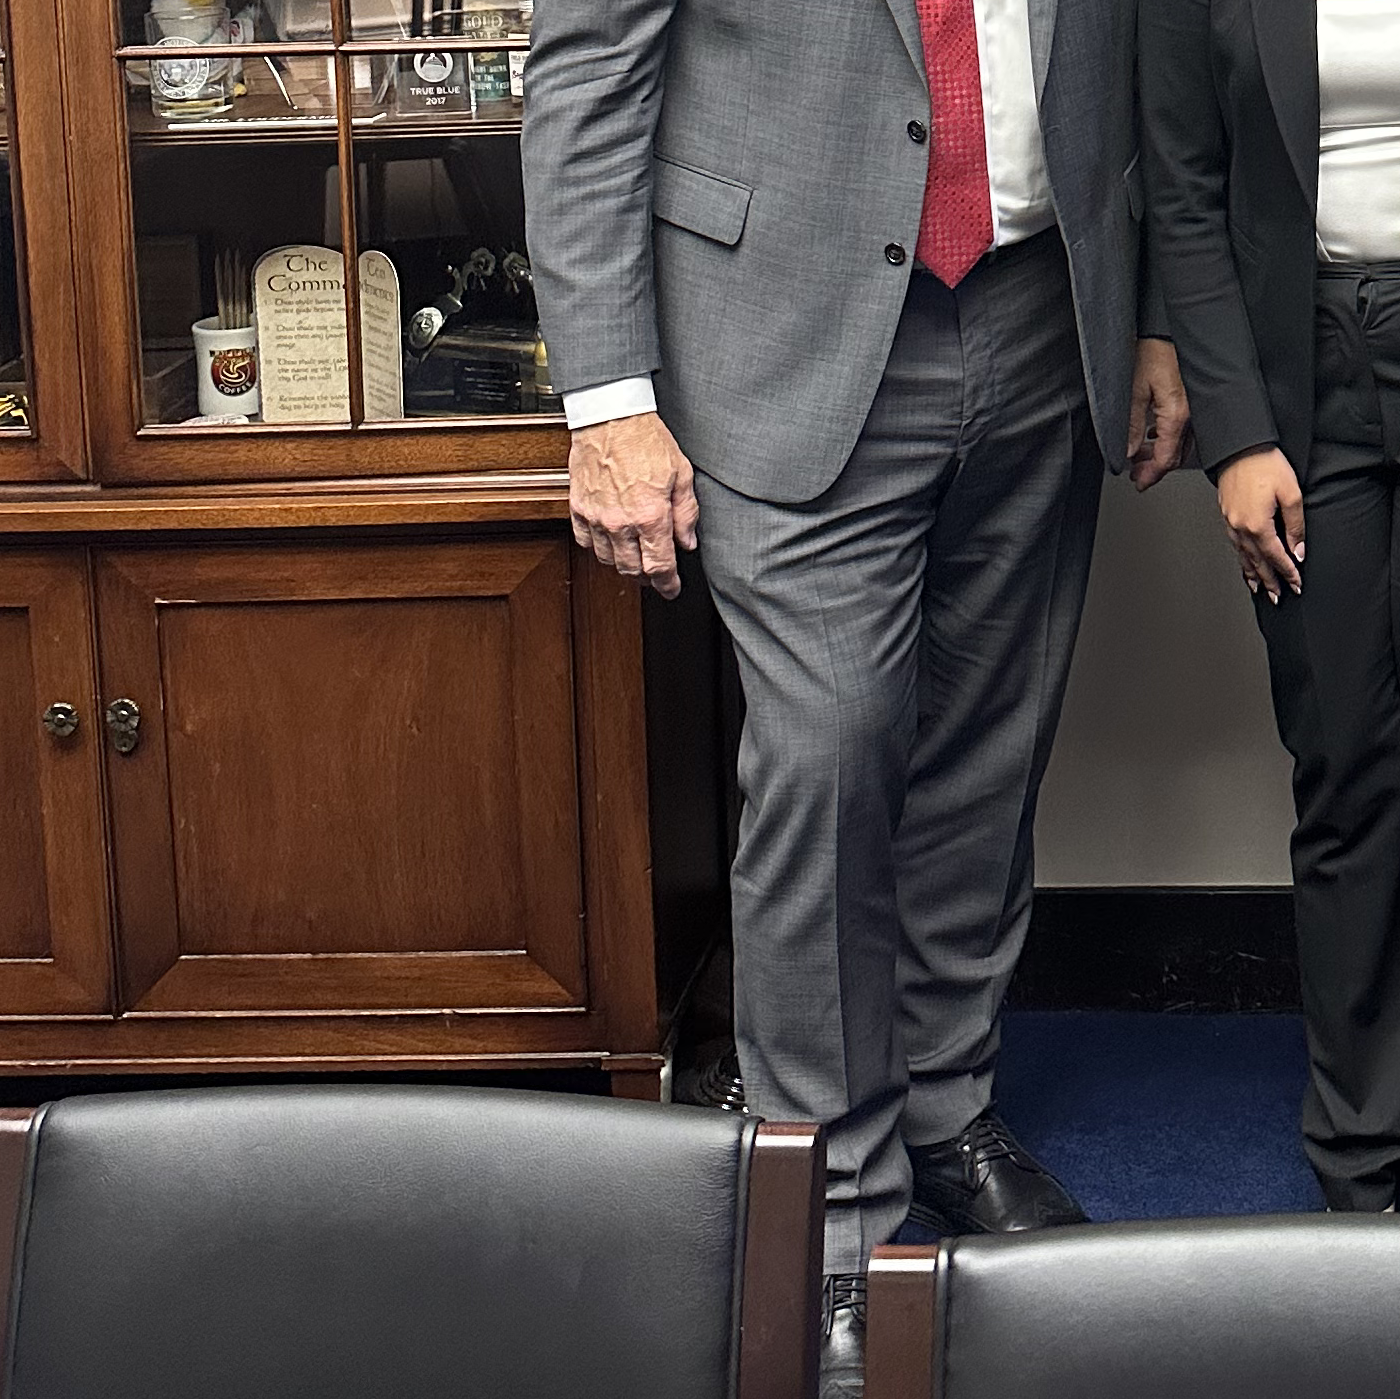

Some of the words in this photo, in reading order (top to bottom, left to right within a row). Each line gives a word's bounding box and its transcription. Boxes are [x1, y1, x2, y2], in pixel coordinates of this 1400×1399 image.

[410, 87, 435, 96] TRUE
[436, 85, 460, 95] BLUE
[425, 97, 446, 106] 2017
[283, 254, 328, 272] The
[366, 257, 386, 280] Ten
[267, 274, 346, 292] Comm
[218, 381, 253, 395] COFFEE
